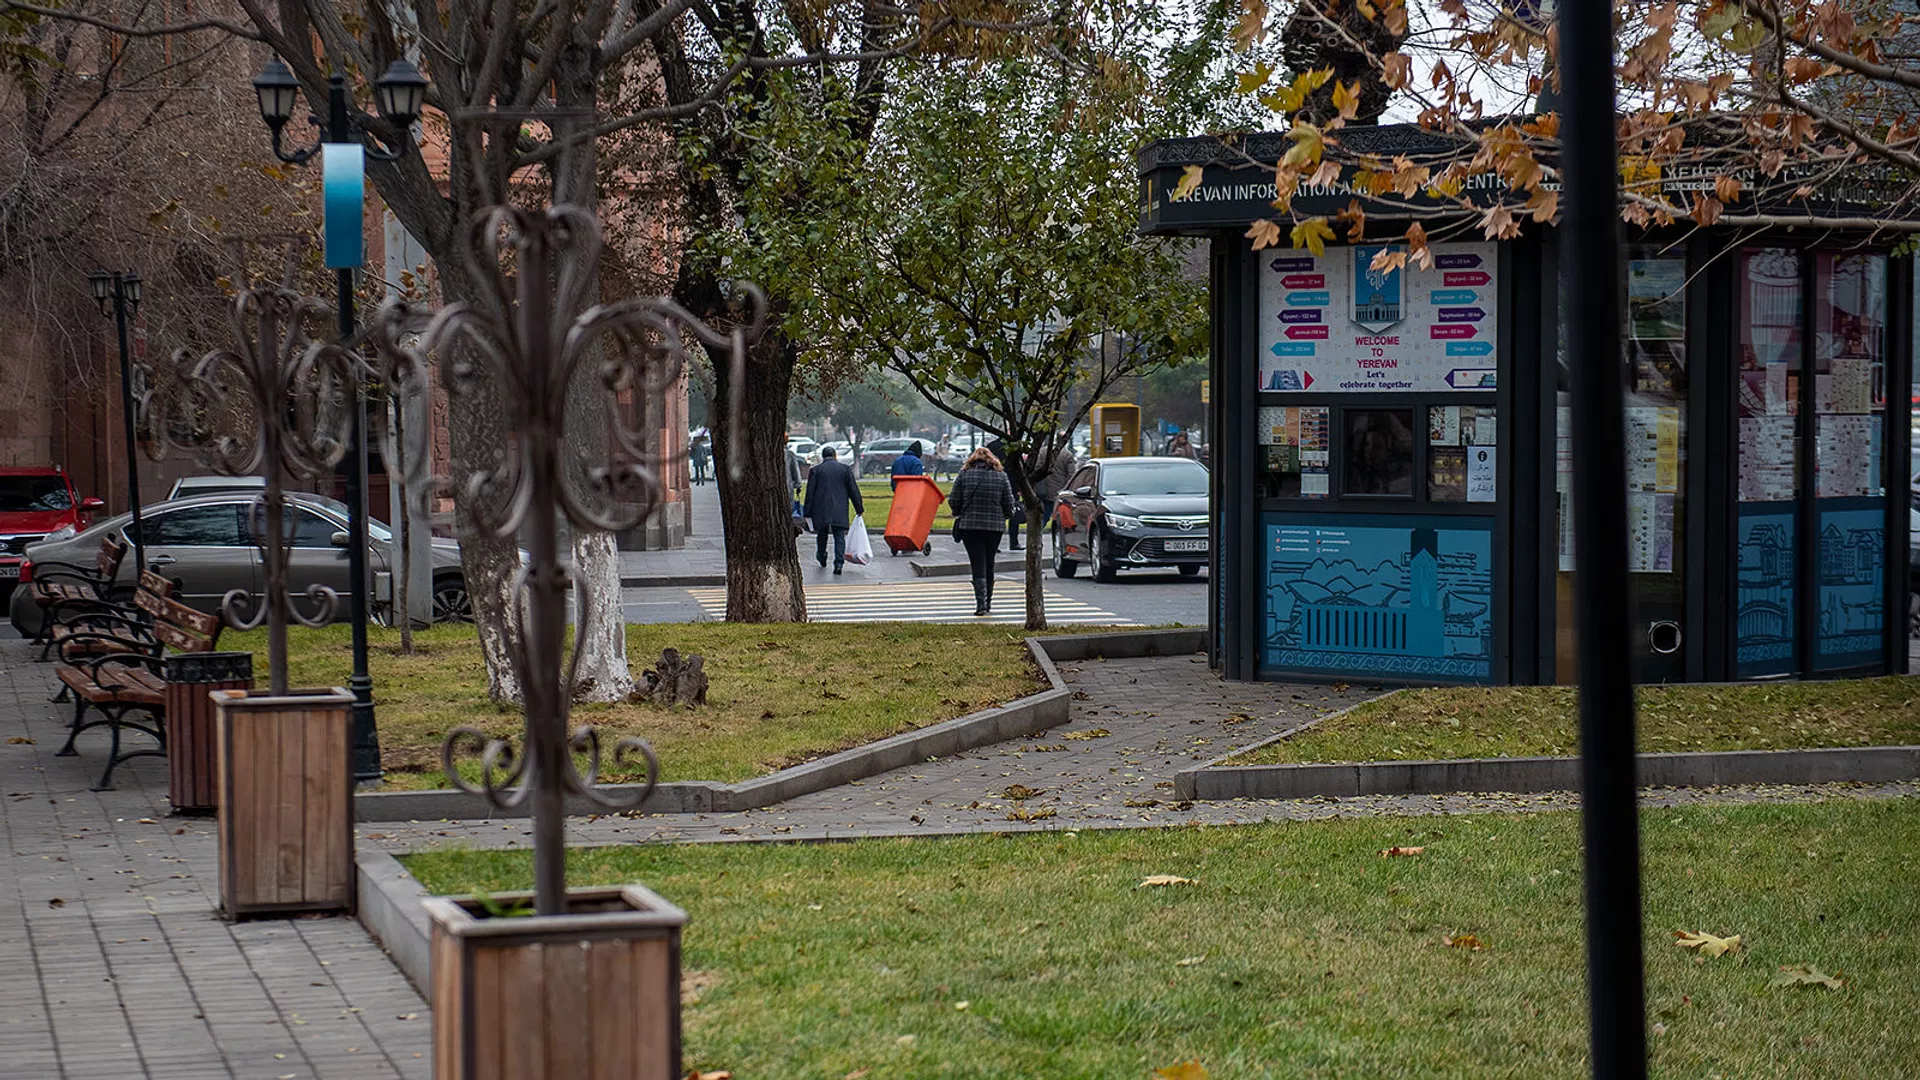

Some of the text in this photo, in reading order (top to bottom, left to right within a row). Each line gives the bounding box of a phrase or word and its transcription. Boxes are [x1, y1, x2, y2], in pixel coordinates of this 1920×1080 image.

[1166, 185, 1232, 203] YREVAN
[1235, 181, 1335, 200] INFORATION
[1355, 336, 1400, 346] WELCOME
[1371, 348, 1384, 357] TO
[1356, 359, 1398, 368] YEREVAN
[1340, 381, 1413, 390] celebrate together
